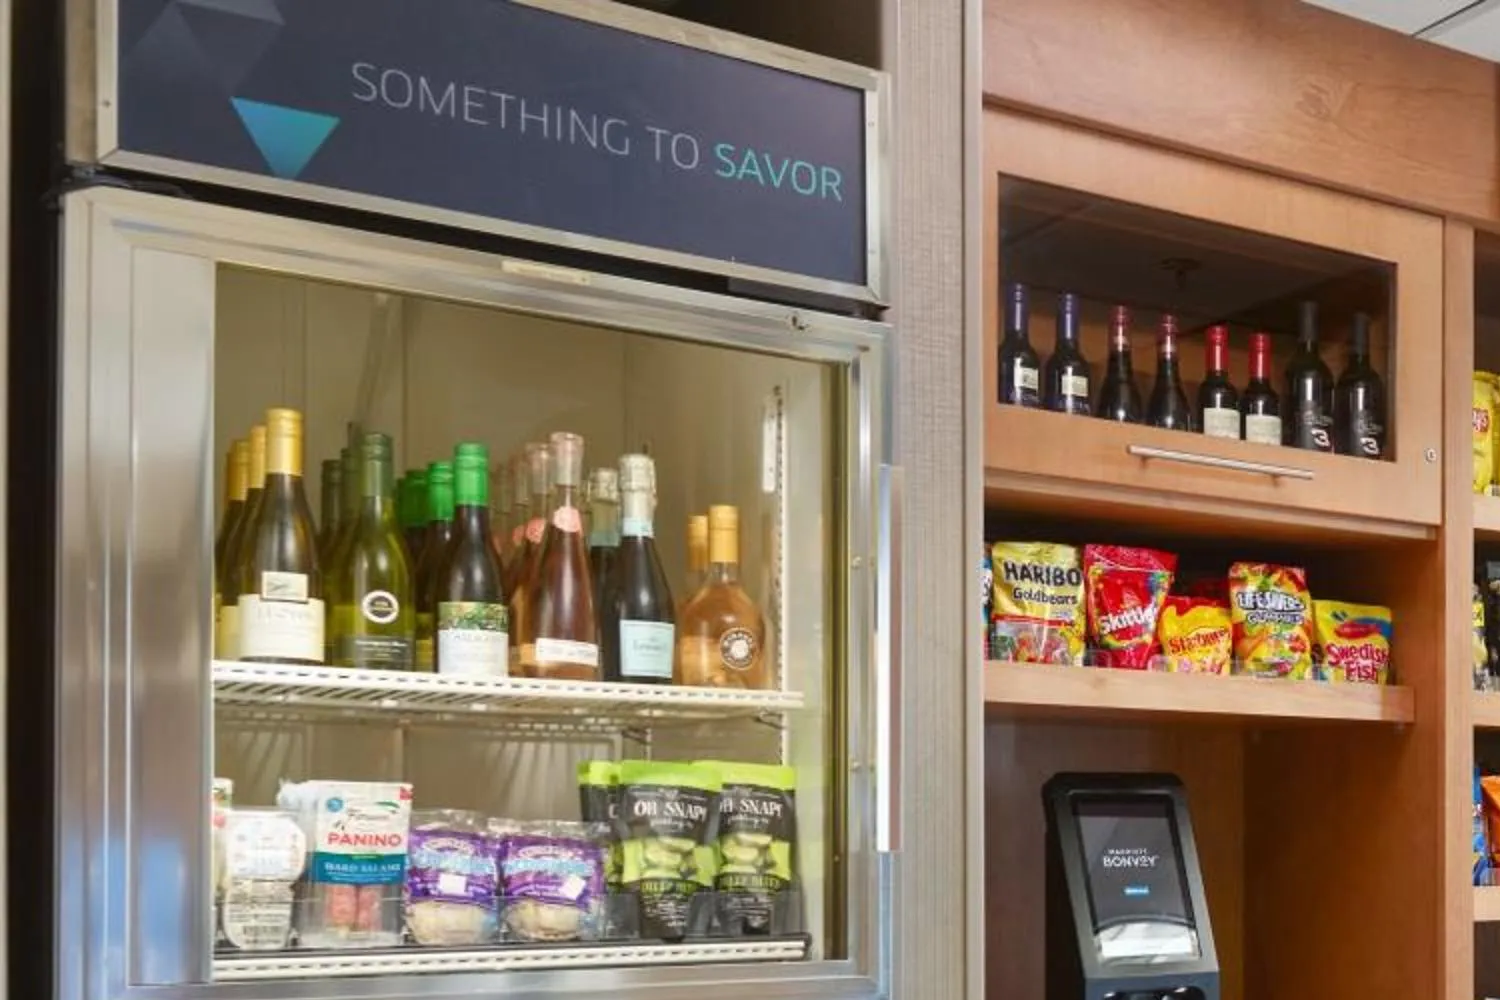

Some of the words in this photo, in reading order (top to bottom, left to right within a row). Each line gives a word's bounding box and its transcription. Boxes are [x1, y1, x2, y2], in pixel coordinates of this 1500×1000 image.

[352, 62, 631, 156] SOMETHING
[647, 126, 699, 169] TO
[715, 142, 843, 202] SAVOR
[1311, 427, 1330, 447] 3
[1360, 437, 1379, 455] 3
[1004, 561, 1081, 587] HARIBO
[1013, 587, 1077, 605] Goldbears
[1326, 643, 1390, 667] Swedish
[1344, 661, 1378, 683] Fish
[634, 803, 658, 816] OH
[327, 831, 402, 847] PANINO
